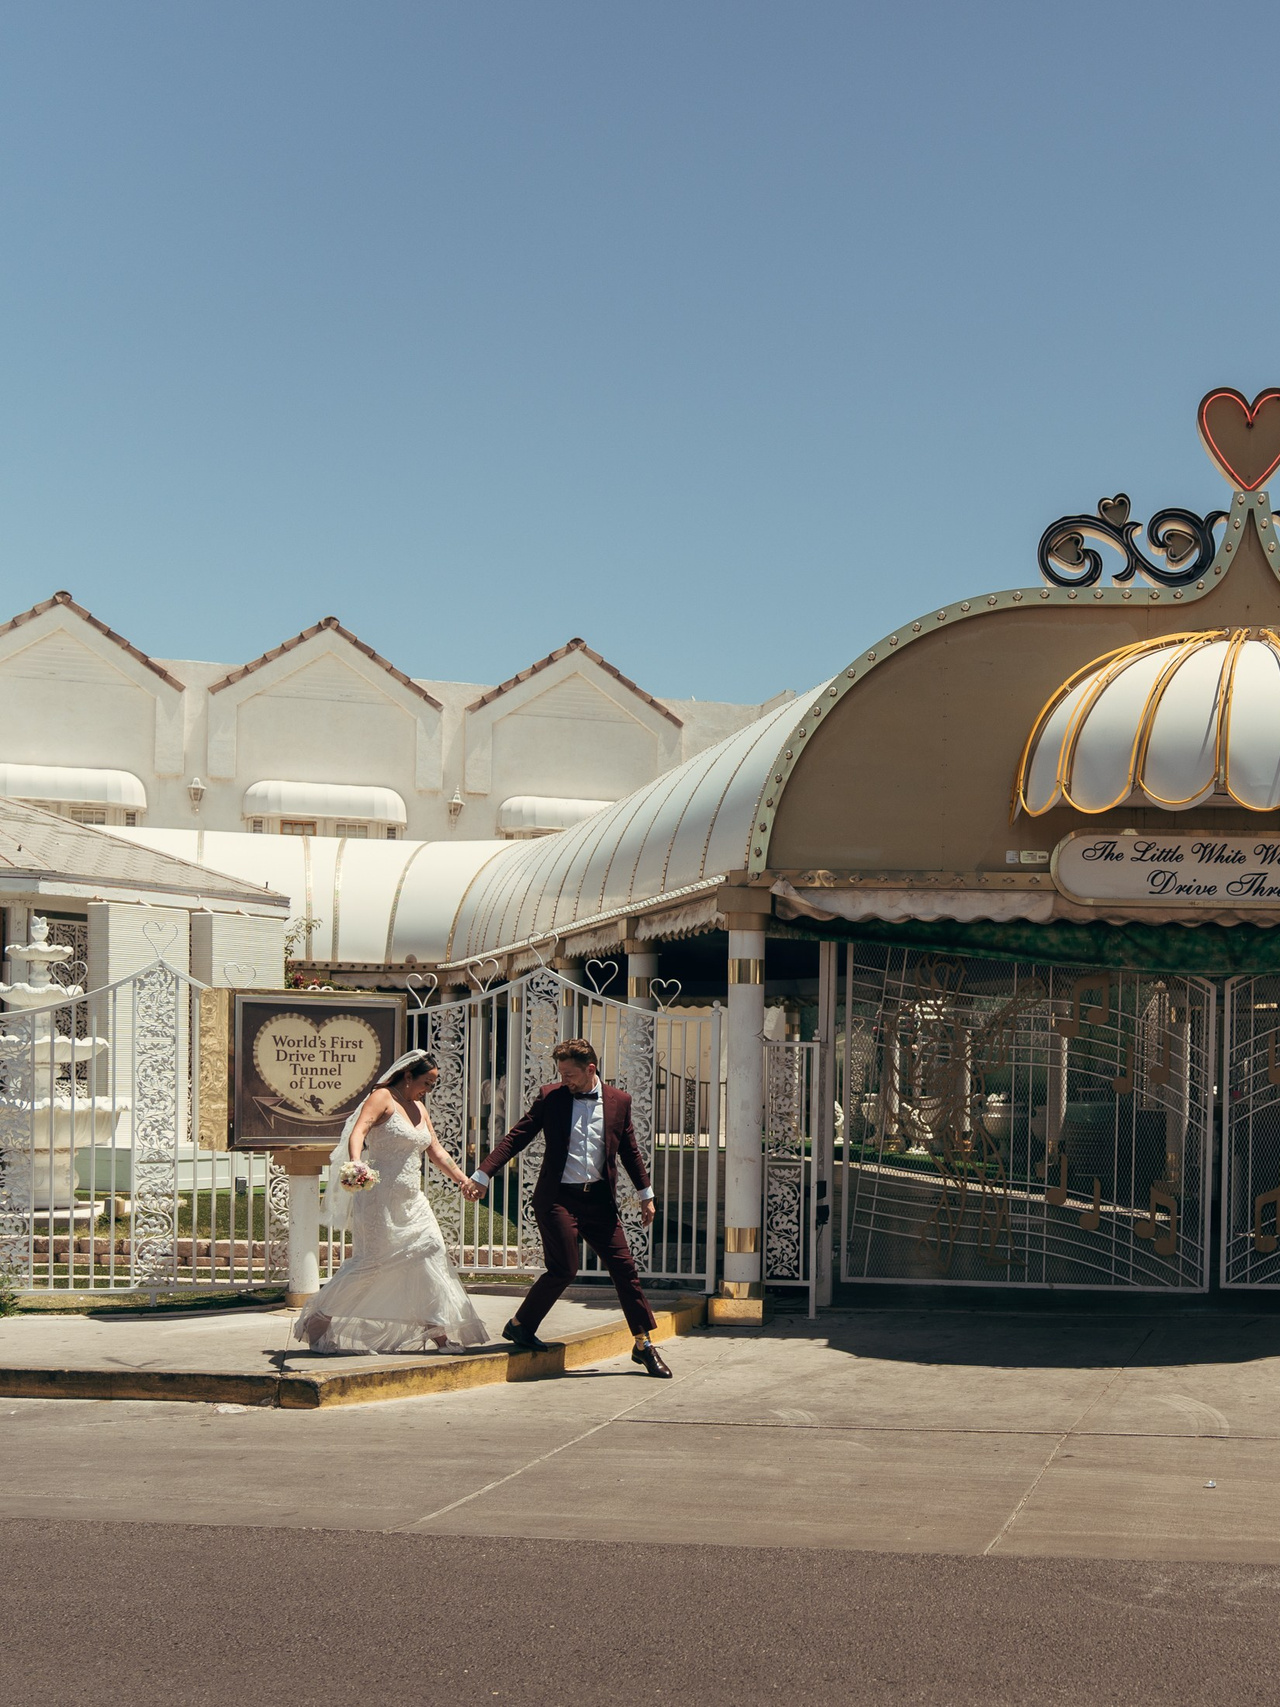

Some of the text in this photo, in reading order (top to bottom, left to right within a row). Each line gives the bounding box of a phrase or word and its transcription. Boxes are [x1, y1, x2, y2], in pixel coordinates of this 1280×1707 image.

[1081, 840, 1125, 861] The
[1130, 840, 1184, 863] Little
[1191, 842, 1247, 864] White
[1146, 869, 1218, 896] Drive
[272, 1034, 364, 1049] World's First
[275, 1049, 356, 1063] Drive Thru
[289, 1063, 342, 1076] Tunnel
[289, 1076, 342, 1090] of Love
